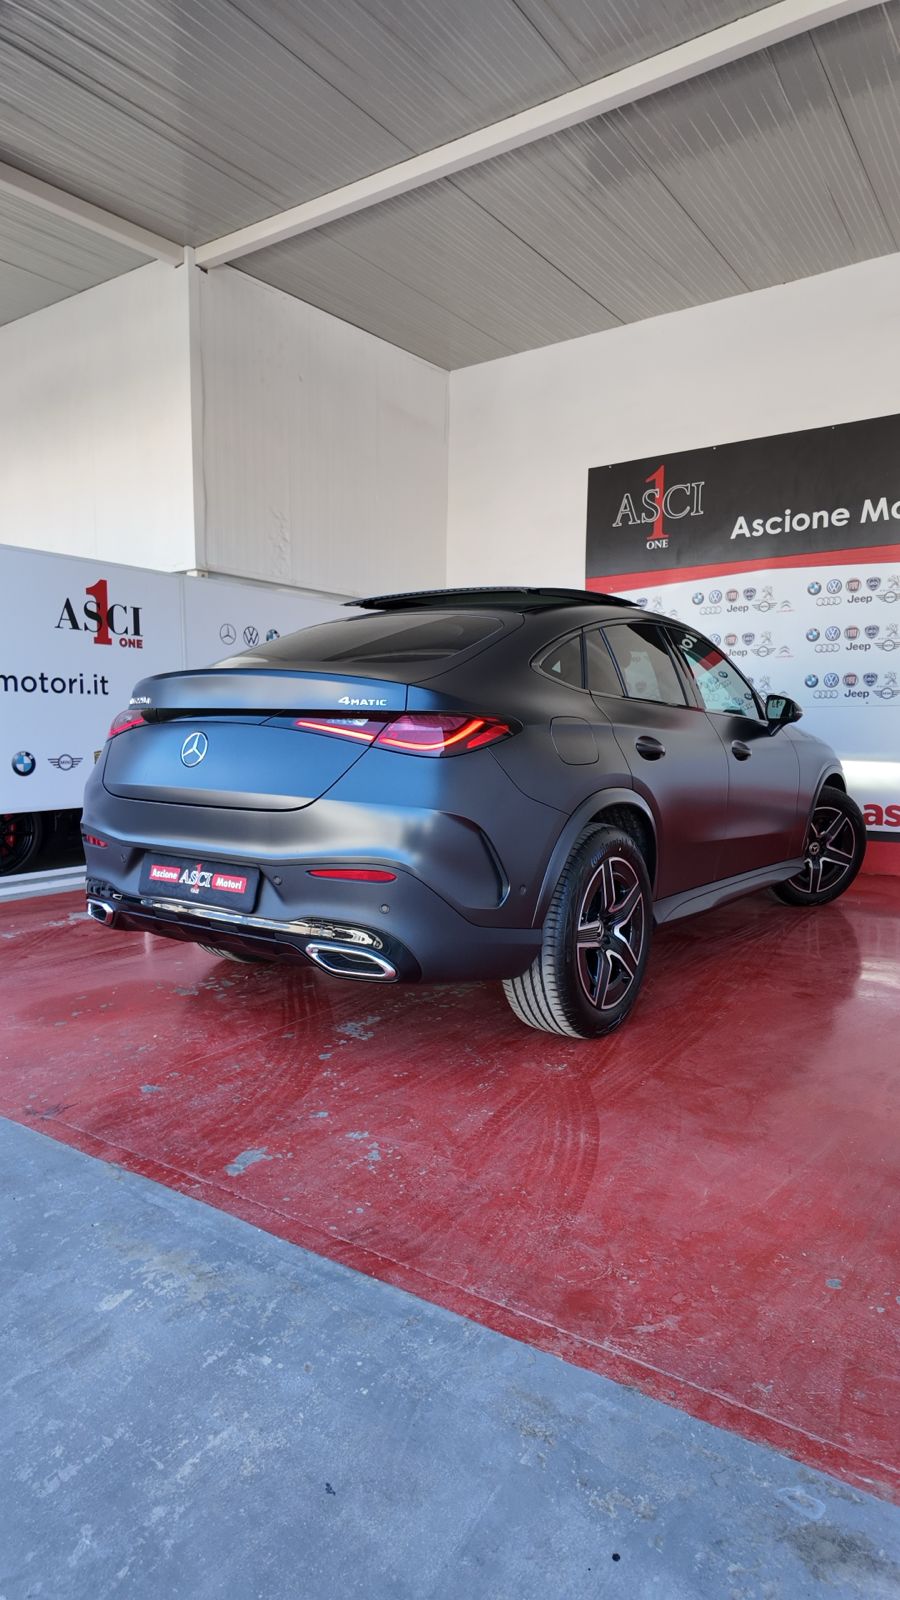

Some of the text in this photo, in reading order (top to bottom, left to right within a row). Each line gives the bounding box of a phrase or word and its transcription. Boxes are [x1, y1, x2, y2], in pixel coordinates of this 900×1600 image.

[612, 481, 705, 528] ASCI
[730, 507, 850, 540] Ascione
[646, 539, 669, 550] ONE
[847, 595, 873, 604] Jeep
[726, 605, 749, 613] Jeep
[54, 597, 144, 637] ASCI
[119, 637, 143, 649] ONE
[846, 642, 871, 652] Jeep
[728, 649, 748, 658] Jeep
[0, 672, 109, 695] motori.it
[844, 690, 870, 699] Jeep
[338, 696, 387, 706] 4MATIC
[863, 803, 900, 827] as
[151, 868, 242, 889] Ascione ASCI Motori
